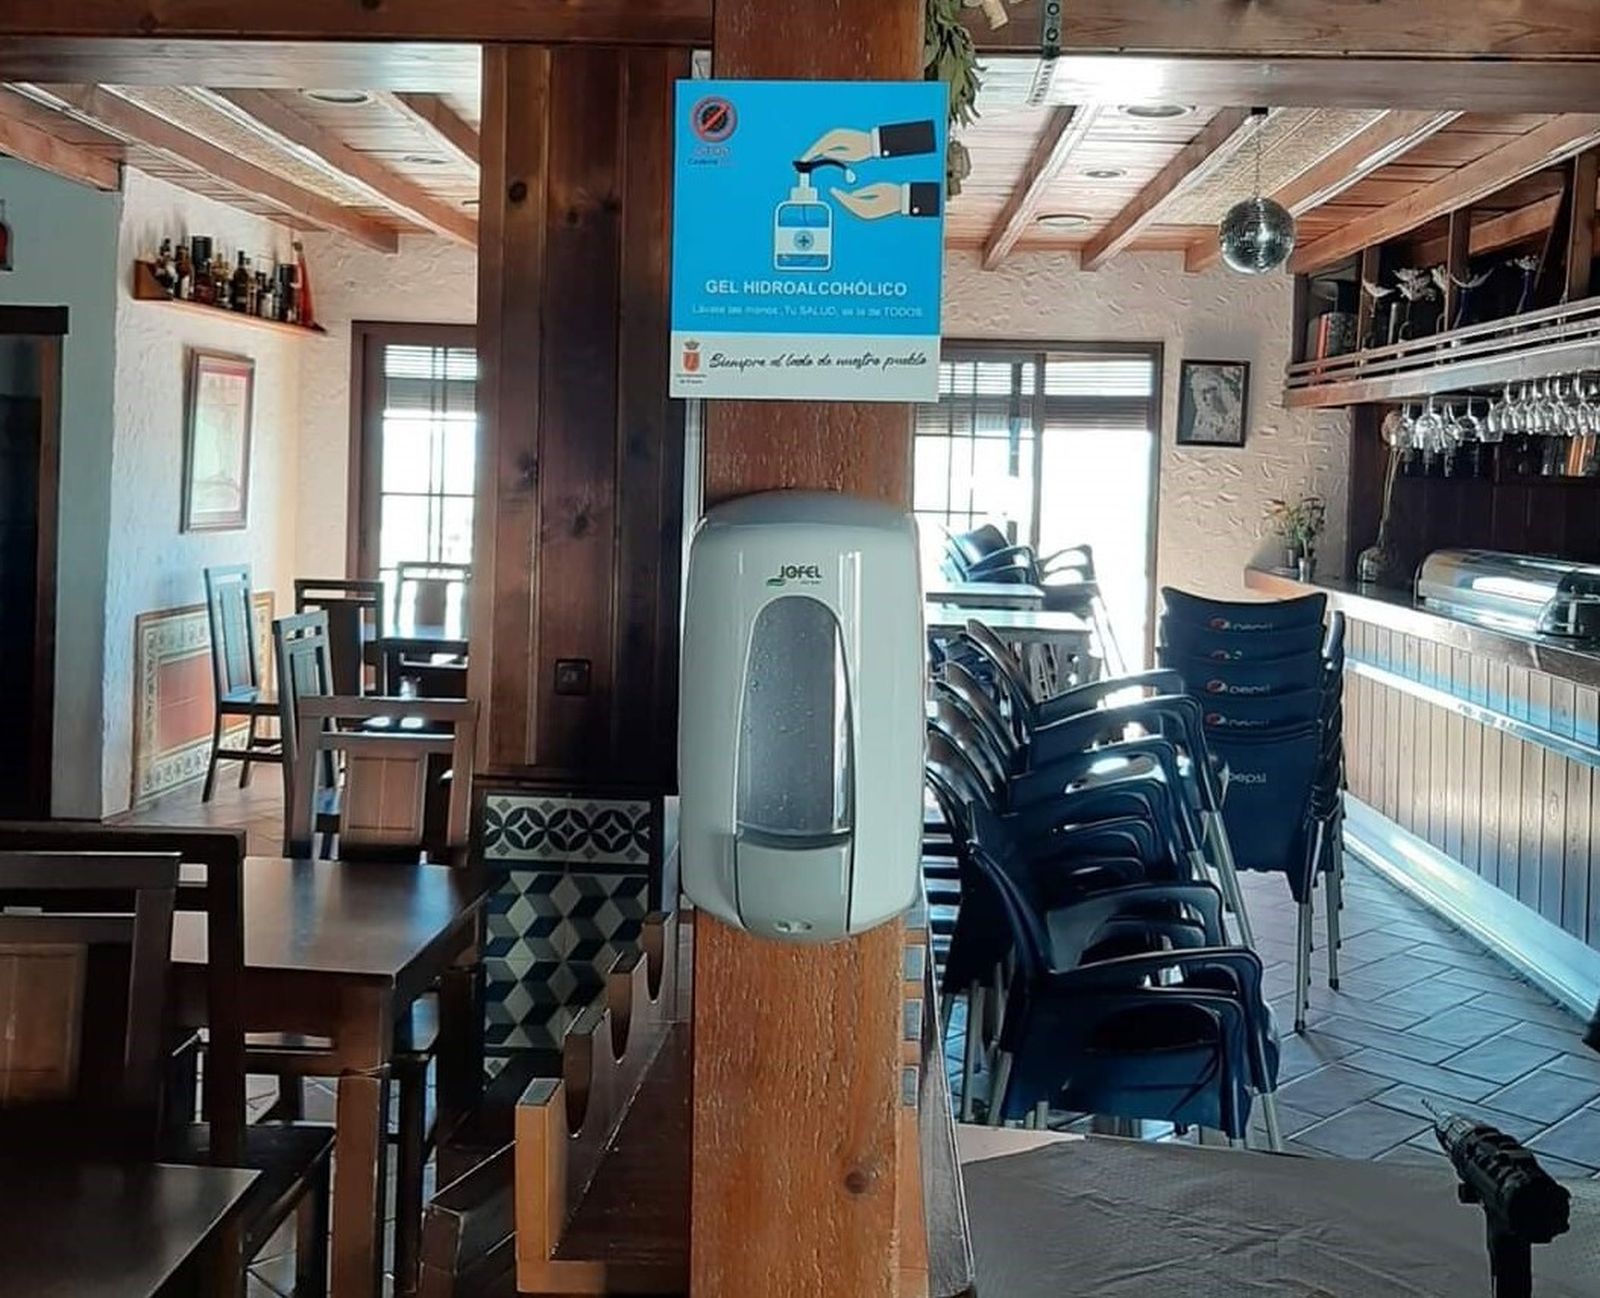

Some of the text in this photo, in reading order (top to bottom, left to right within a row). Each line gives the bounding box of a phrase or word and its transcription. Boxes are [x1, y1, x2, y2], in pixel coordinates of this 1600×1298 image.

[705, 279, 908, 297] GEL HIDROALCOHÓLICO
[709, 353, 765, 373] Siempre
[818, 353, 831, 367] de
[836, 352, 880, 370] nuestro
[881, 352, 927, 372] pueblo
[779, 565, 822, 579] JOFEL
